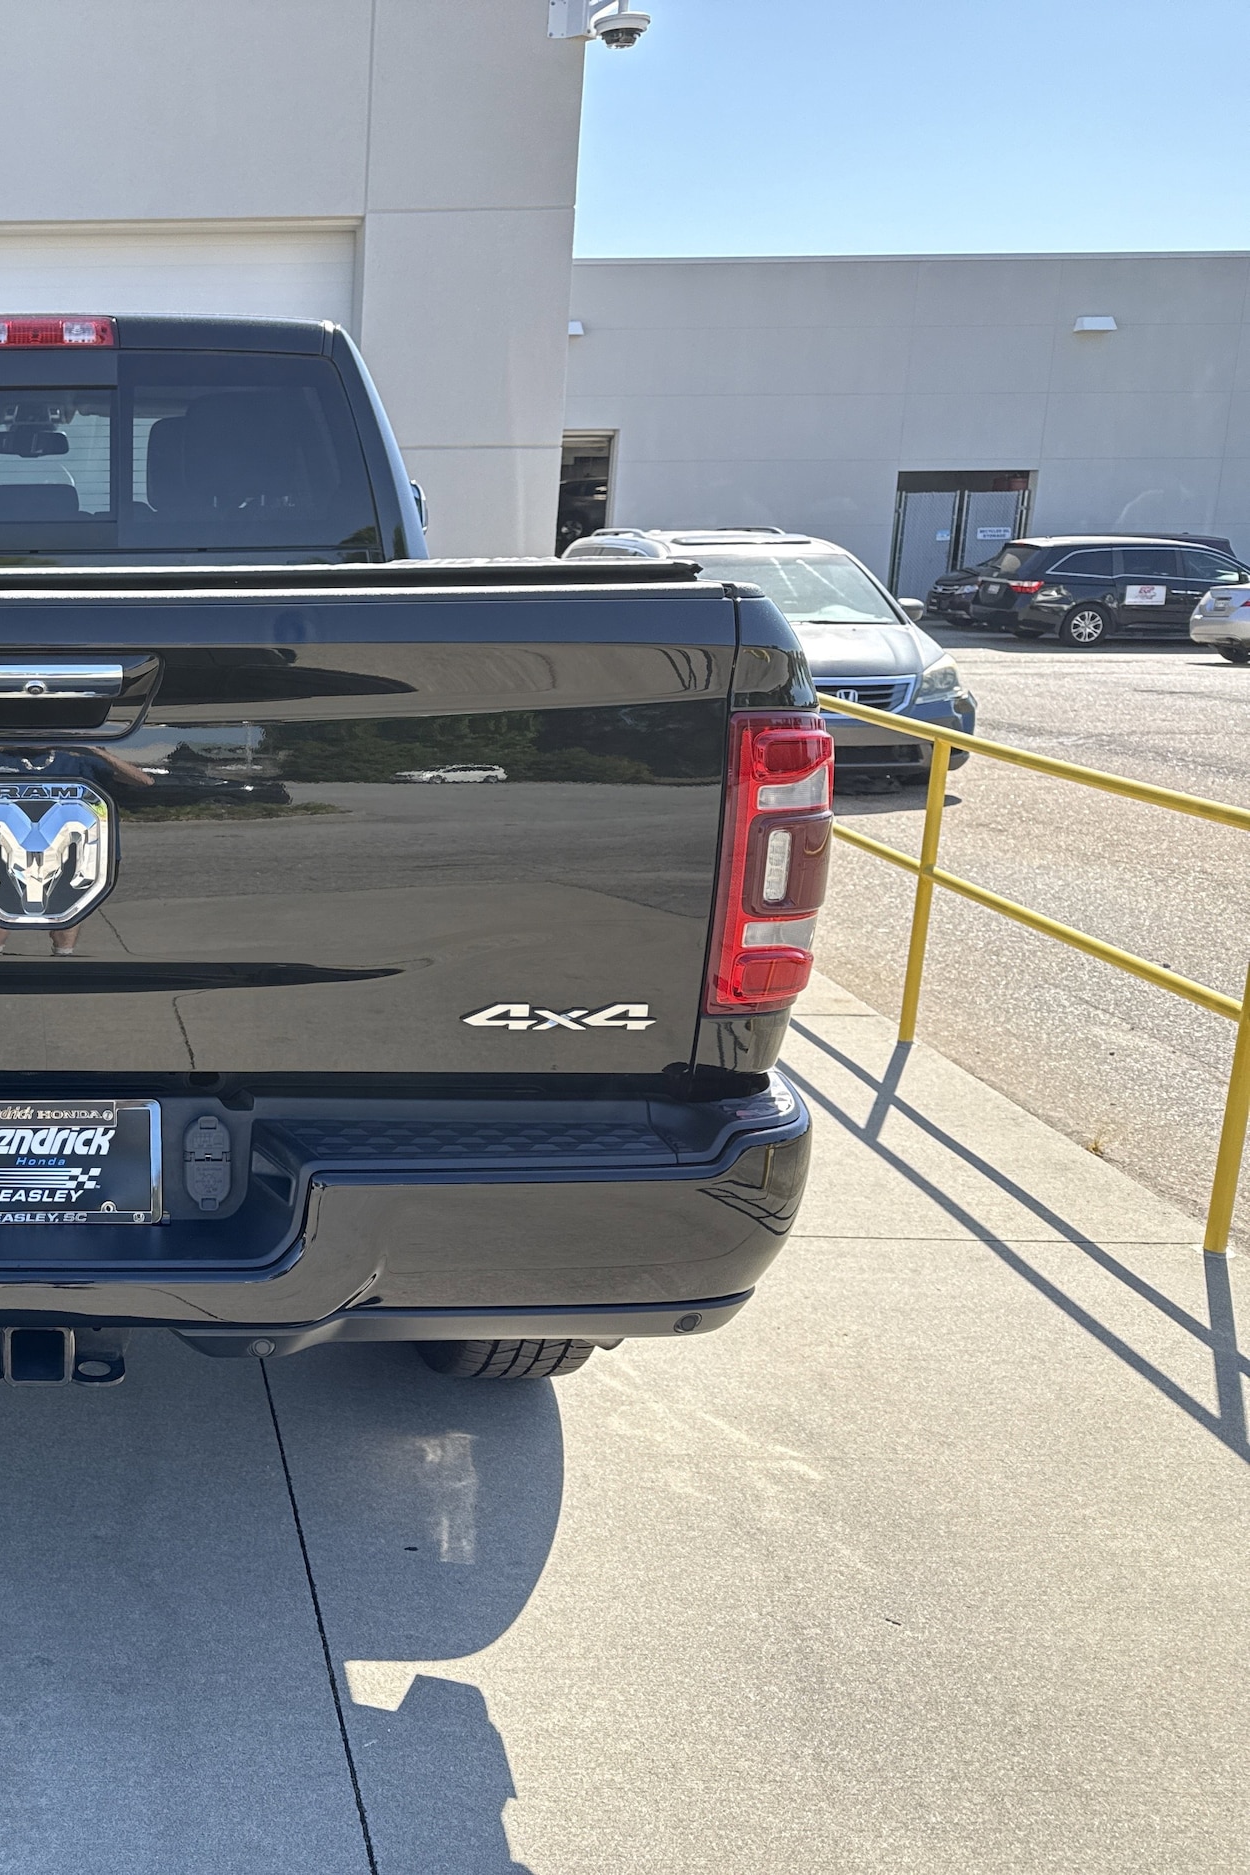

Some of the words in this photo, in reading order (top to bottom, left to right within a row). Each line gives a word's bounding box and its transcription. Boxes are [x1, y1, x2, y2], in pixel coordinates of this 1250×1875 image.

[461, 1002, 657, 1030] 4x4
[37, 1110, 102, 1119] HONDA
[16, 1157, 66, 1166] Honda
[63, 1213, 88, 1222] SC
